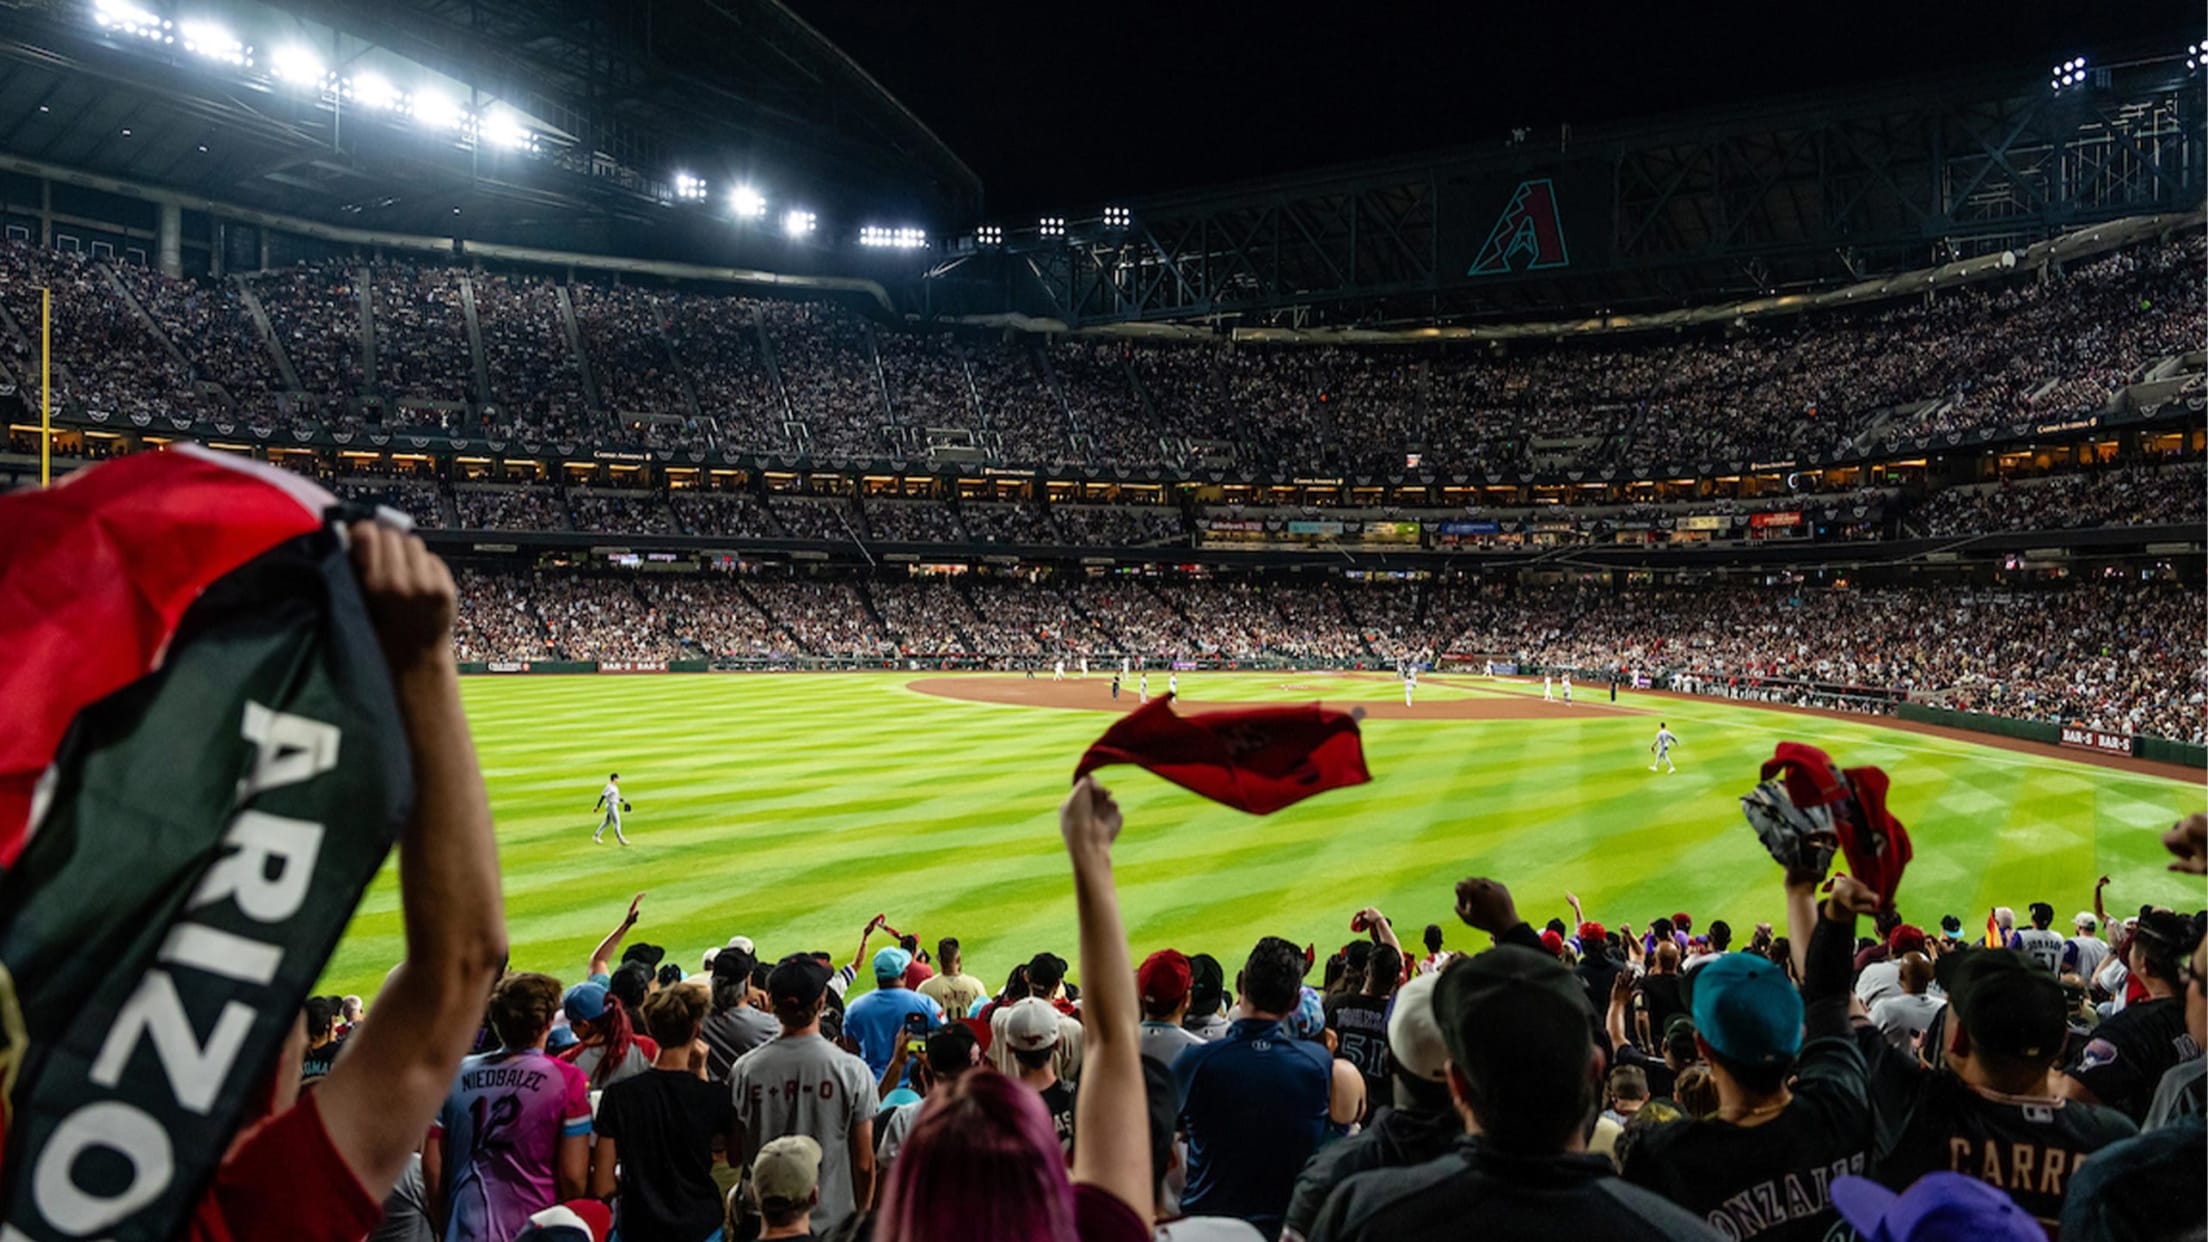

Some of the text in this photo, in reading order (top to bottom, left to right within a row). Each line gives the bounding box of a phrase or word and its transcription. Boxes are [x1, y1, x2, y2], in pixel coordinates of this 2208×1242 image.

[602, 662, 666, 670] BAR-S BAR-S
[2063, 730, 2130, 751] BAR-S BAR-S
[2, 700, 342, 1242] ARIZO
[468, 1093, 523, 1156] 12
[1949, 1137, 2086, 1196] CARR
